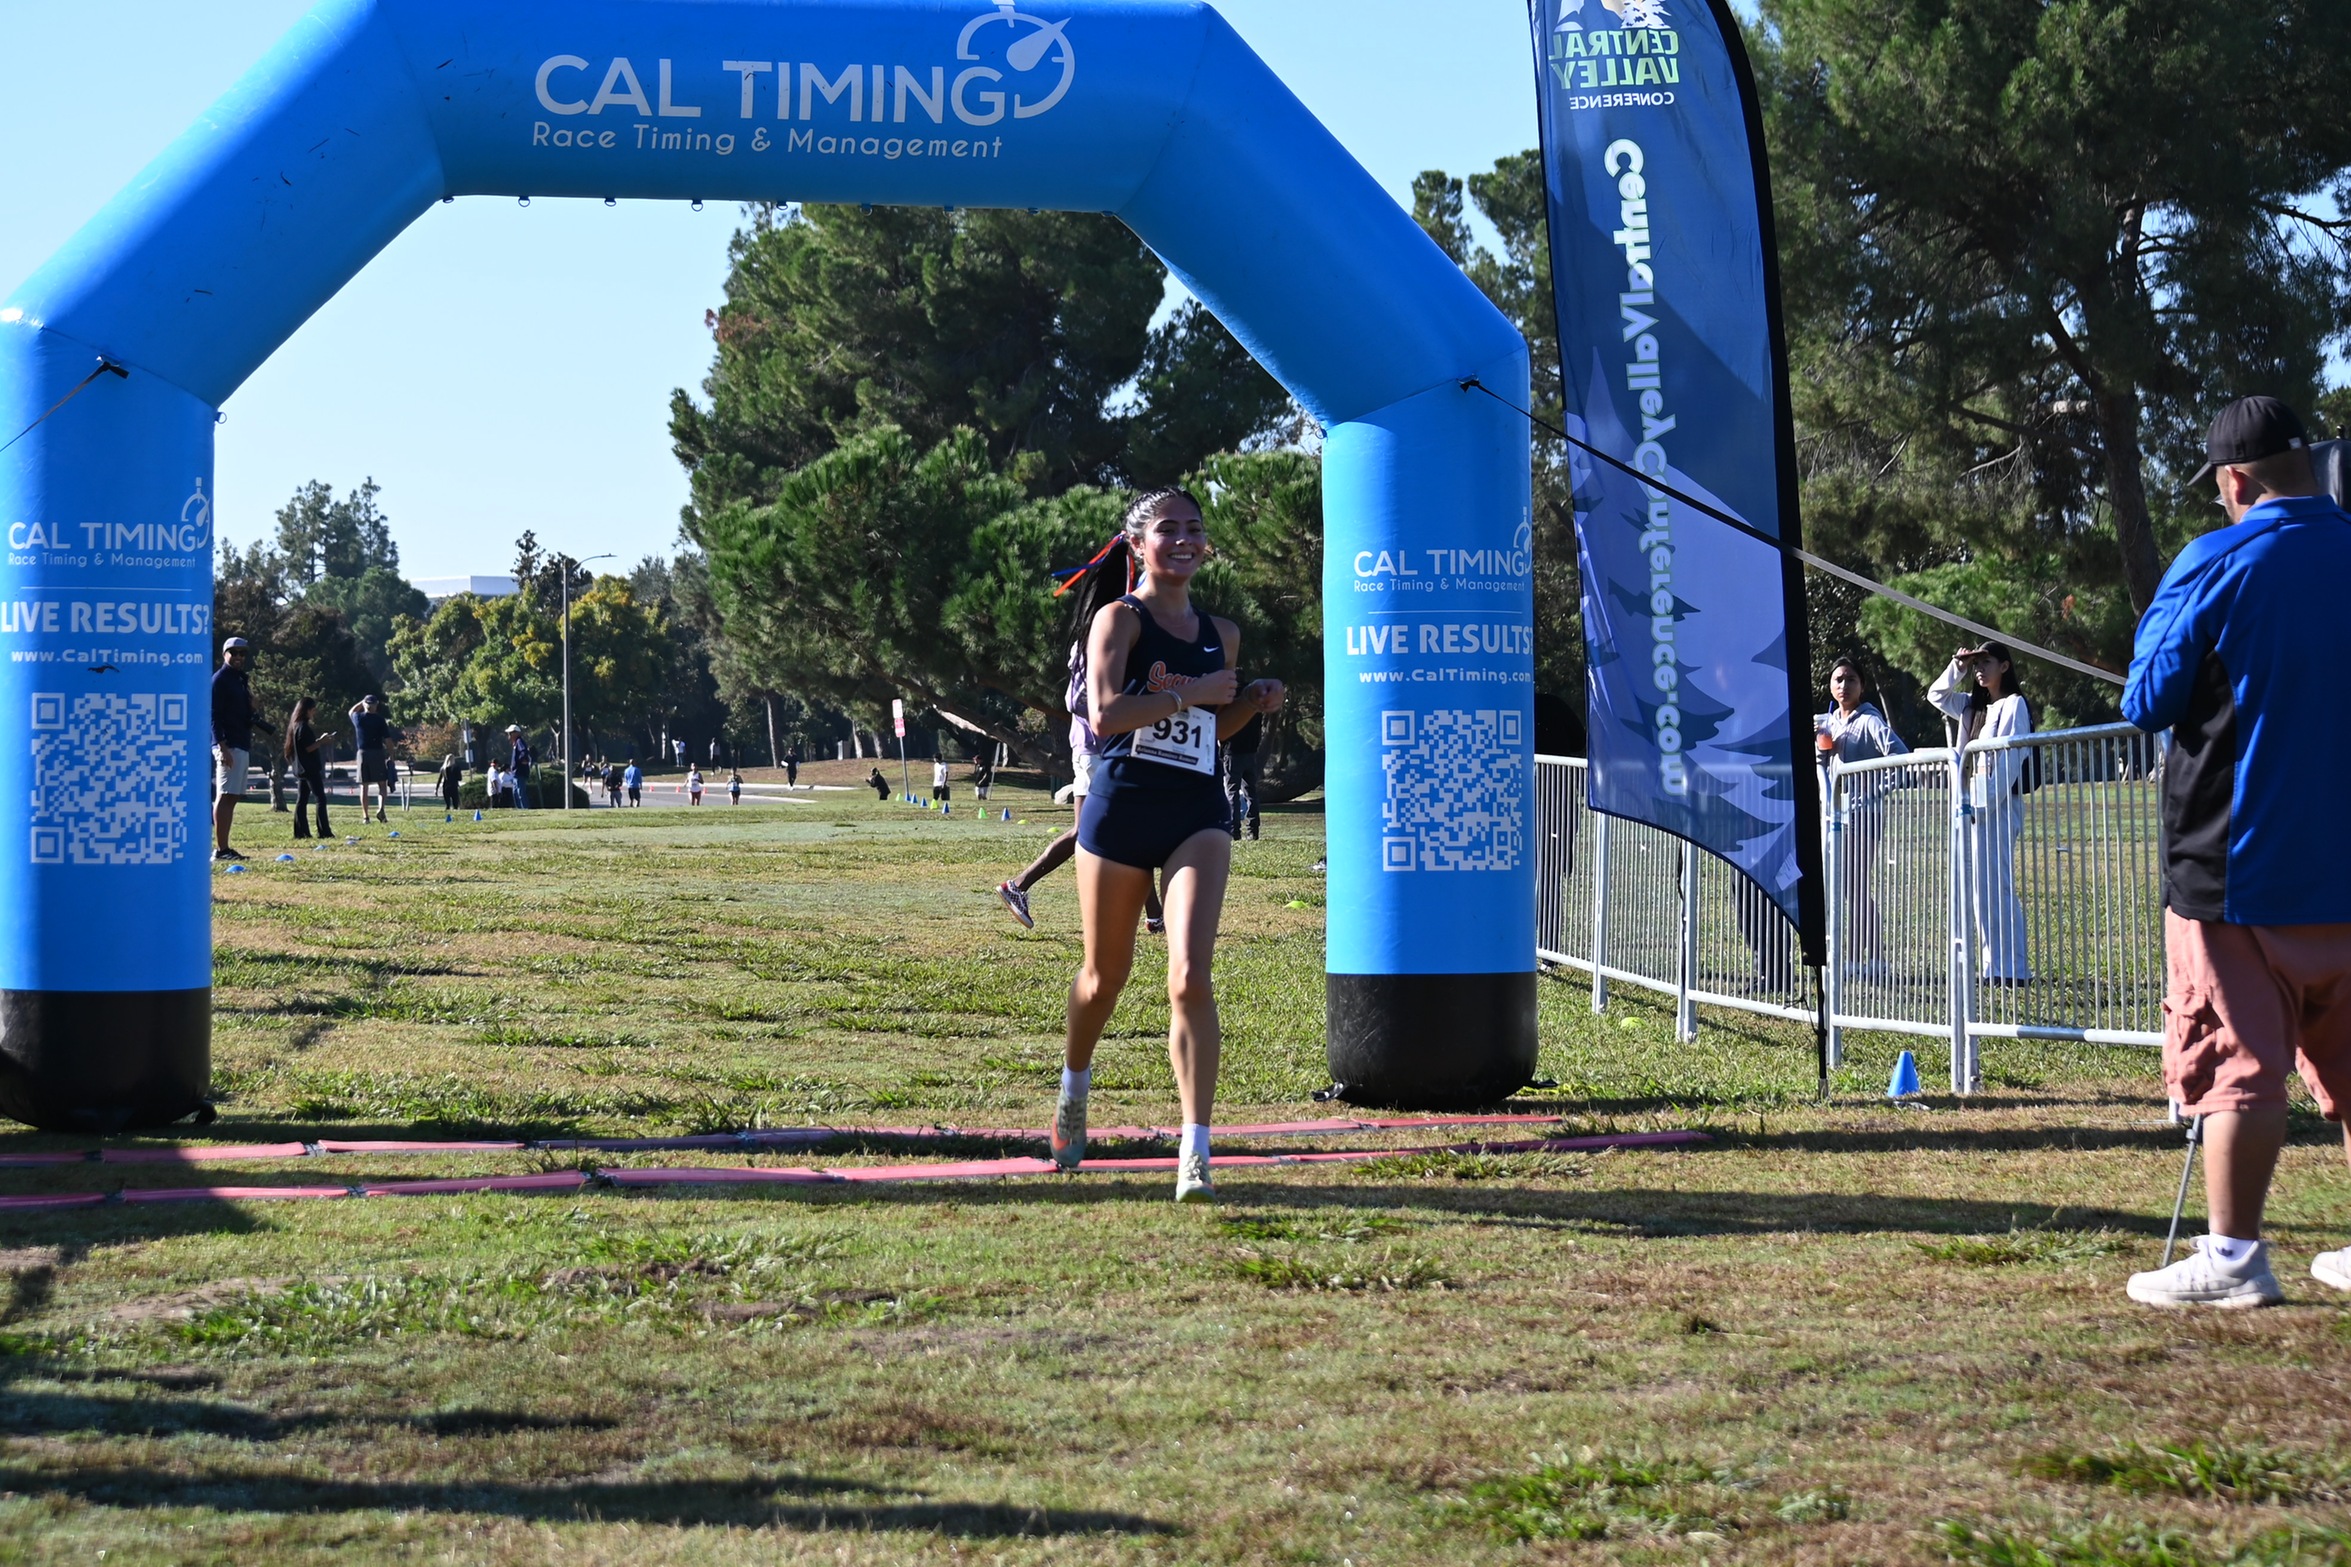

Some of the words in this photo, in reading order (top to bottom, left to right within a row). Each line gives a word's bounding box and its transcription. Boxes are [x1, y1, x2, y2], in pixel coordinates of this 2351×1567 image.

[534, 54, 702, 119] CAL
[722, 59, 1006, 127] TIMING
[532, 121, 617, 149] Race
[632, 123, 736, 156] Timing
[751, 127, 771, 151] &
[787, 128, 1003, 160] Management
[8, 521, 72, 550] CAL
[79, 521, 196, 553] TIMING
[8, 552, 37, 566] Race
[42, 552, 87, 568] Timing
[94, 552, 104, 566] &
[111, 553, 196, 569] Management
[1353, 550, 1419, 578] CAL
[1426, 549, 1525, 577] TIMING
[1353, 578, 1385, 593] Race
[1389, 578, 1434, 593] Timing
[1440, 577, 1450, 590] &
[1455, 577, 1525, 593] Management
[1, 601, 61, 633] LIVE
[70, 602, 210, 635] RESULTS?
[1346, 624, 1409, 656] LIVE
[11, 648, 204, 667] www.CalTiming.com
[1359, 667, 1532, 685] www.CalTiming.com
